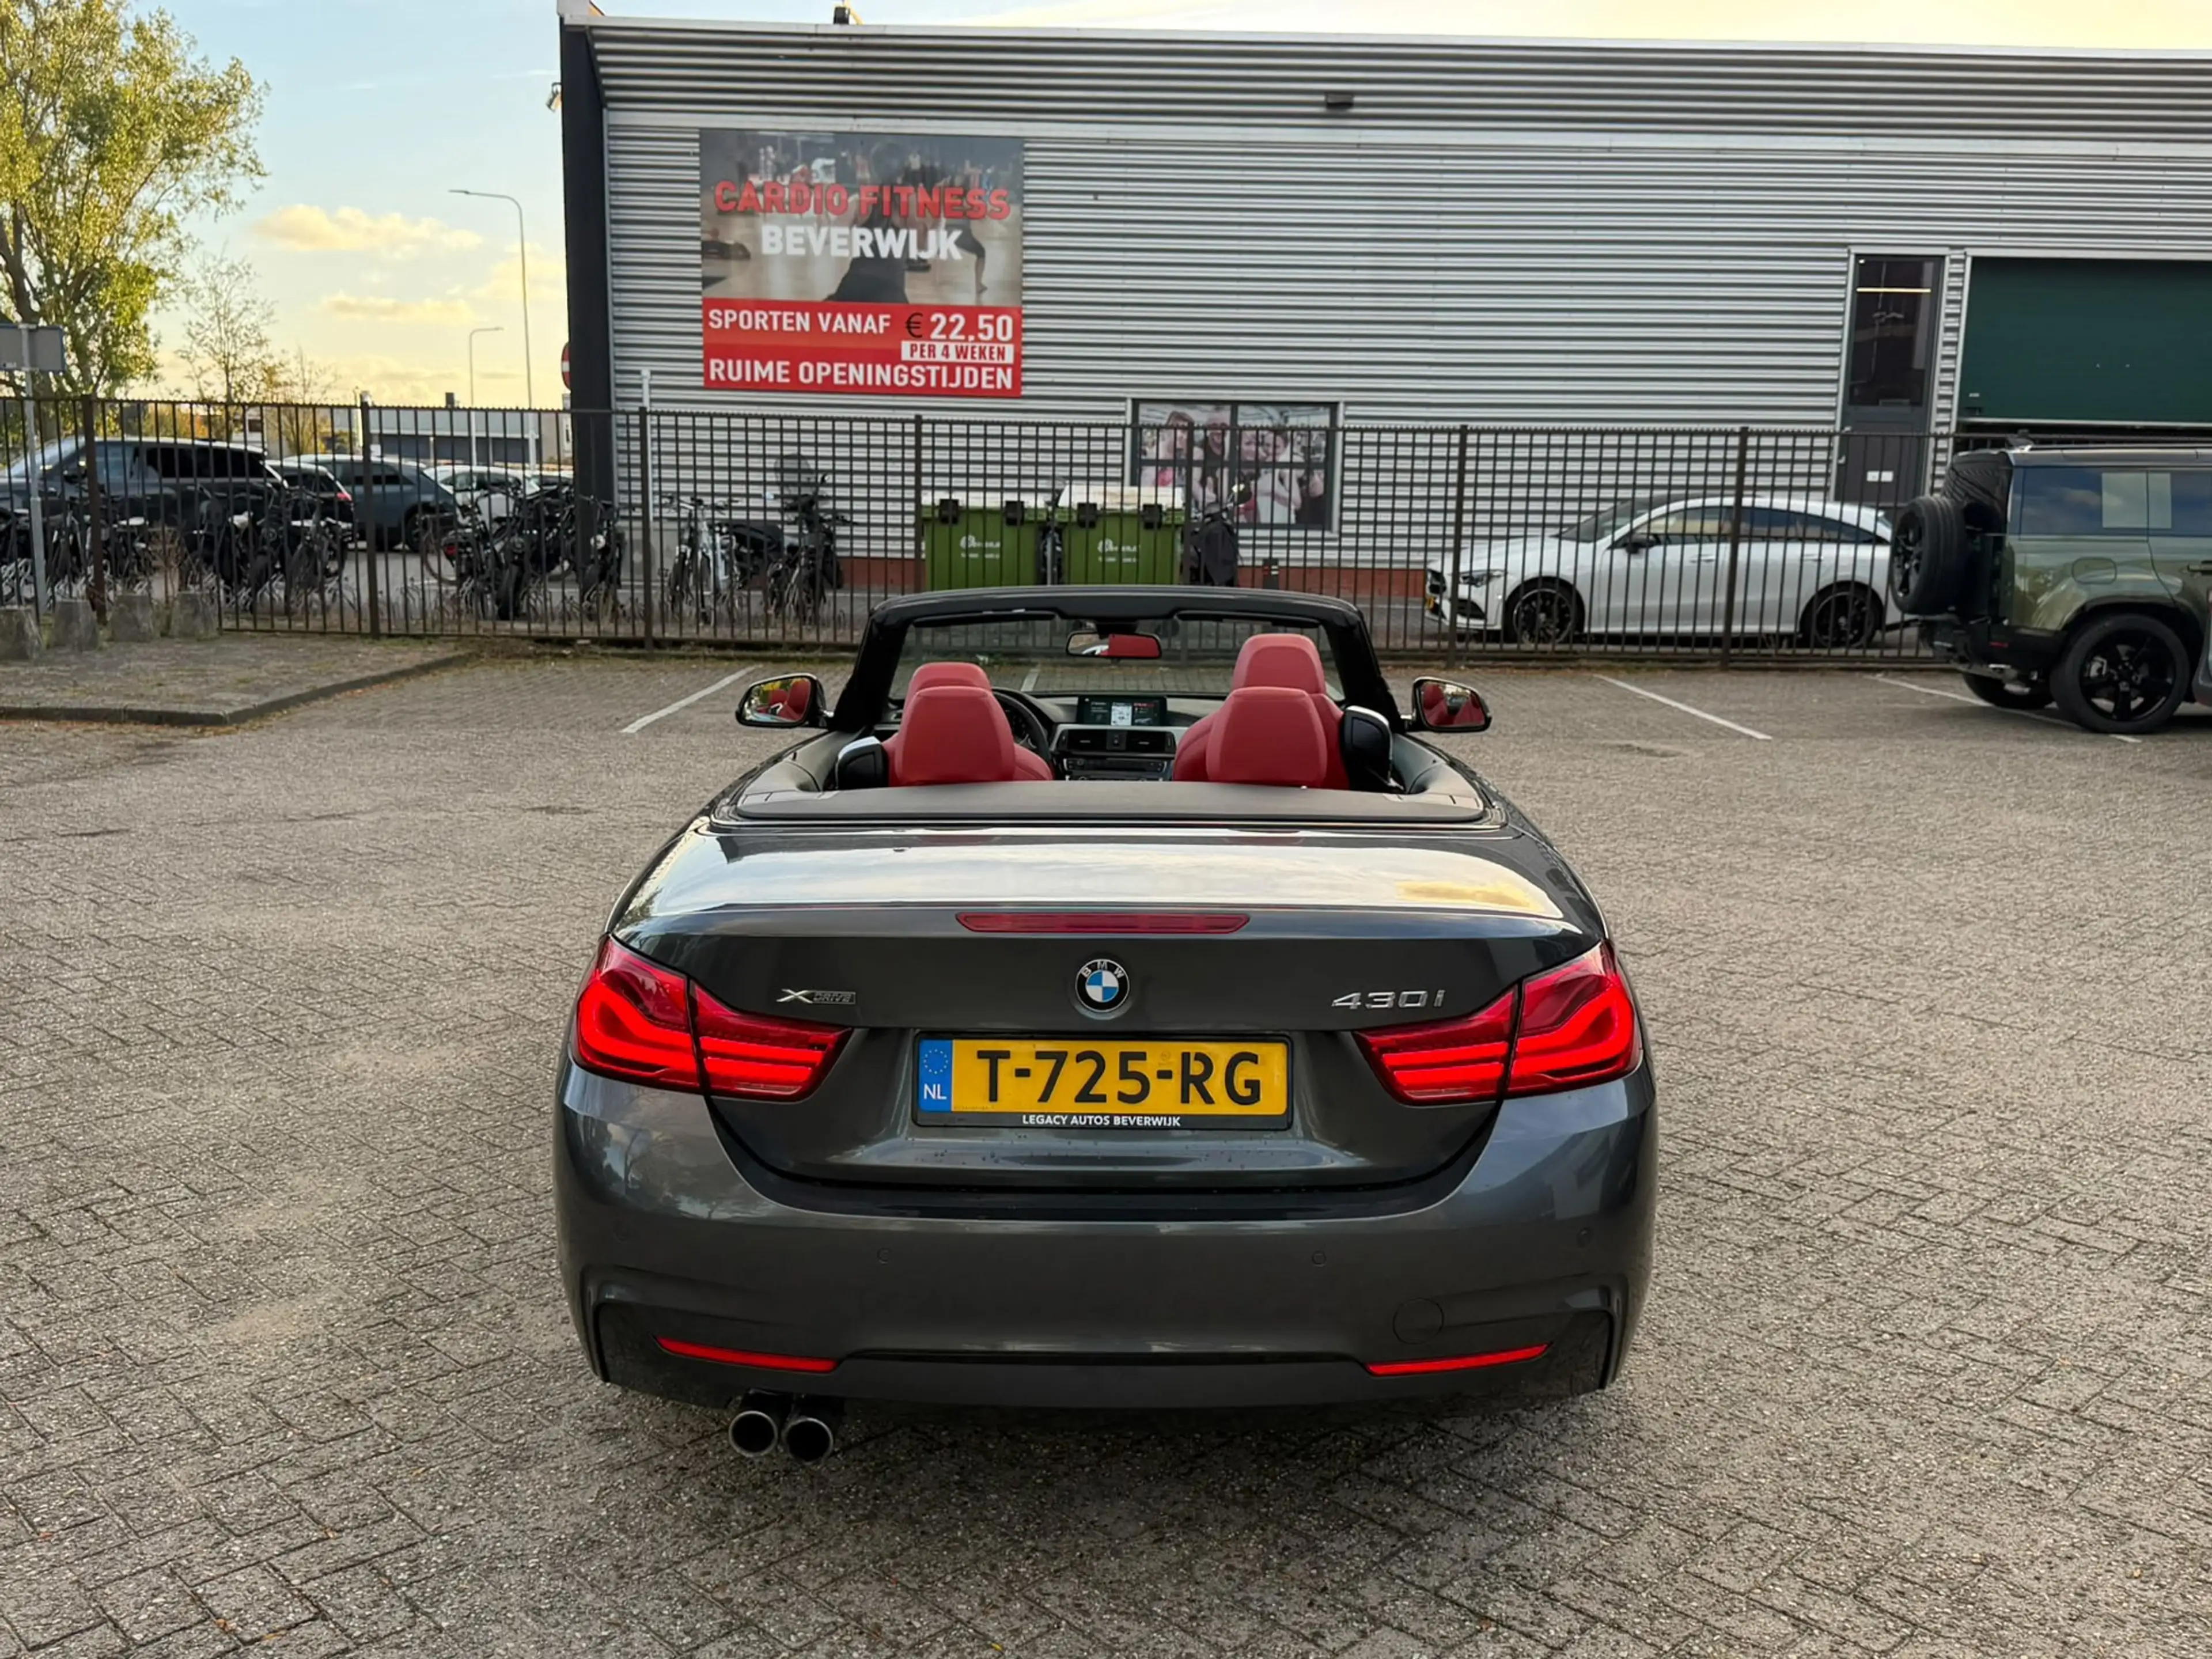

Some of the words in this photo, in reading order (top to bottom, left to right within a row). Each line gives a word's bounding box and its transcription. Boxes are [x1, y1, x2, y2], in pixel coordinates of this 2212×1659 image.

[714, 180, 849, 217] CARDIO
[859, 184, 1011, 220] FITNESS
[762, 225, 963, 260] BEVERWIJK
[709, 309, 810, 332] SPORTEN
[818, 312, 891, 334] VANAF
[905, 312, 923, 338] €
[910, 344, 936, 359] PER
[941, 344, 949, 359] 4
[955, 344, 1005, 361] WEKEN
[709, 358, 790, 383] RUIME
[798, 361, 1012, 389] OPENINGSTIJDEN
[1081, 961, 1124, 979] BMW
[923, 1084, 946, 1100] NL
[977, 1050, 1262, 1105] T-725-RG
[1022, 1115, 1067, 1124] LEGACY
[1070, 1115, 1110, 1126] AUTOS
[1113, 1116, 1181, 1127] BEVERWIJK
